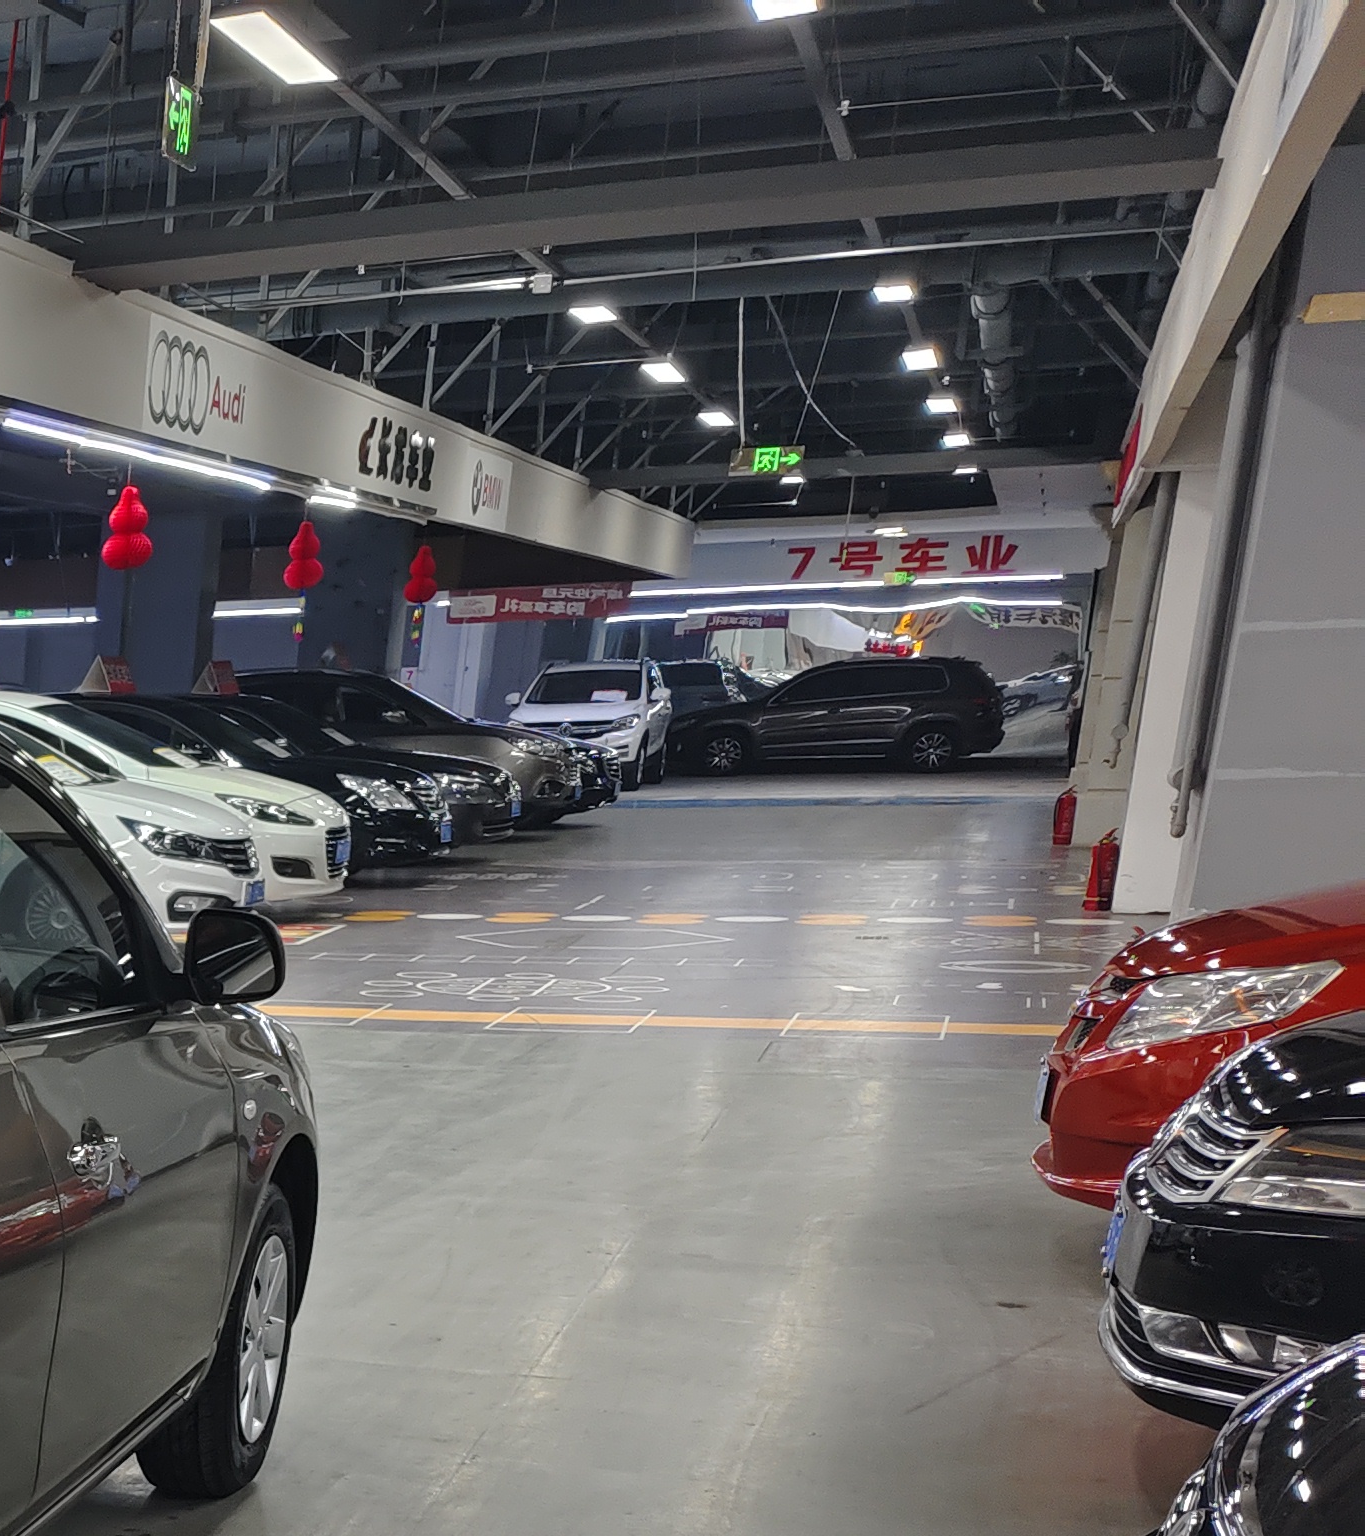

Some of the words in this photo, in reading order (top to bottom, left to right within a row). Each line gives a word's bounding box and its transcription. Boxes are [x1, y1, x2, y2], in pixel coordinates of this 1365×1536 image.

[209, 375, 246, 424] Audi
[481, 480, 503, 511] BMW
[788, 535, 1018, 579] 7号车业
